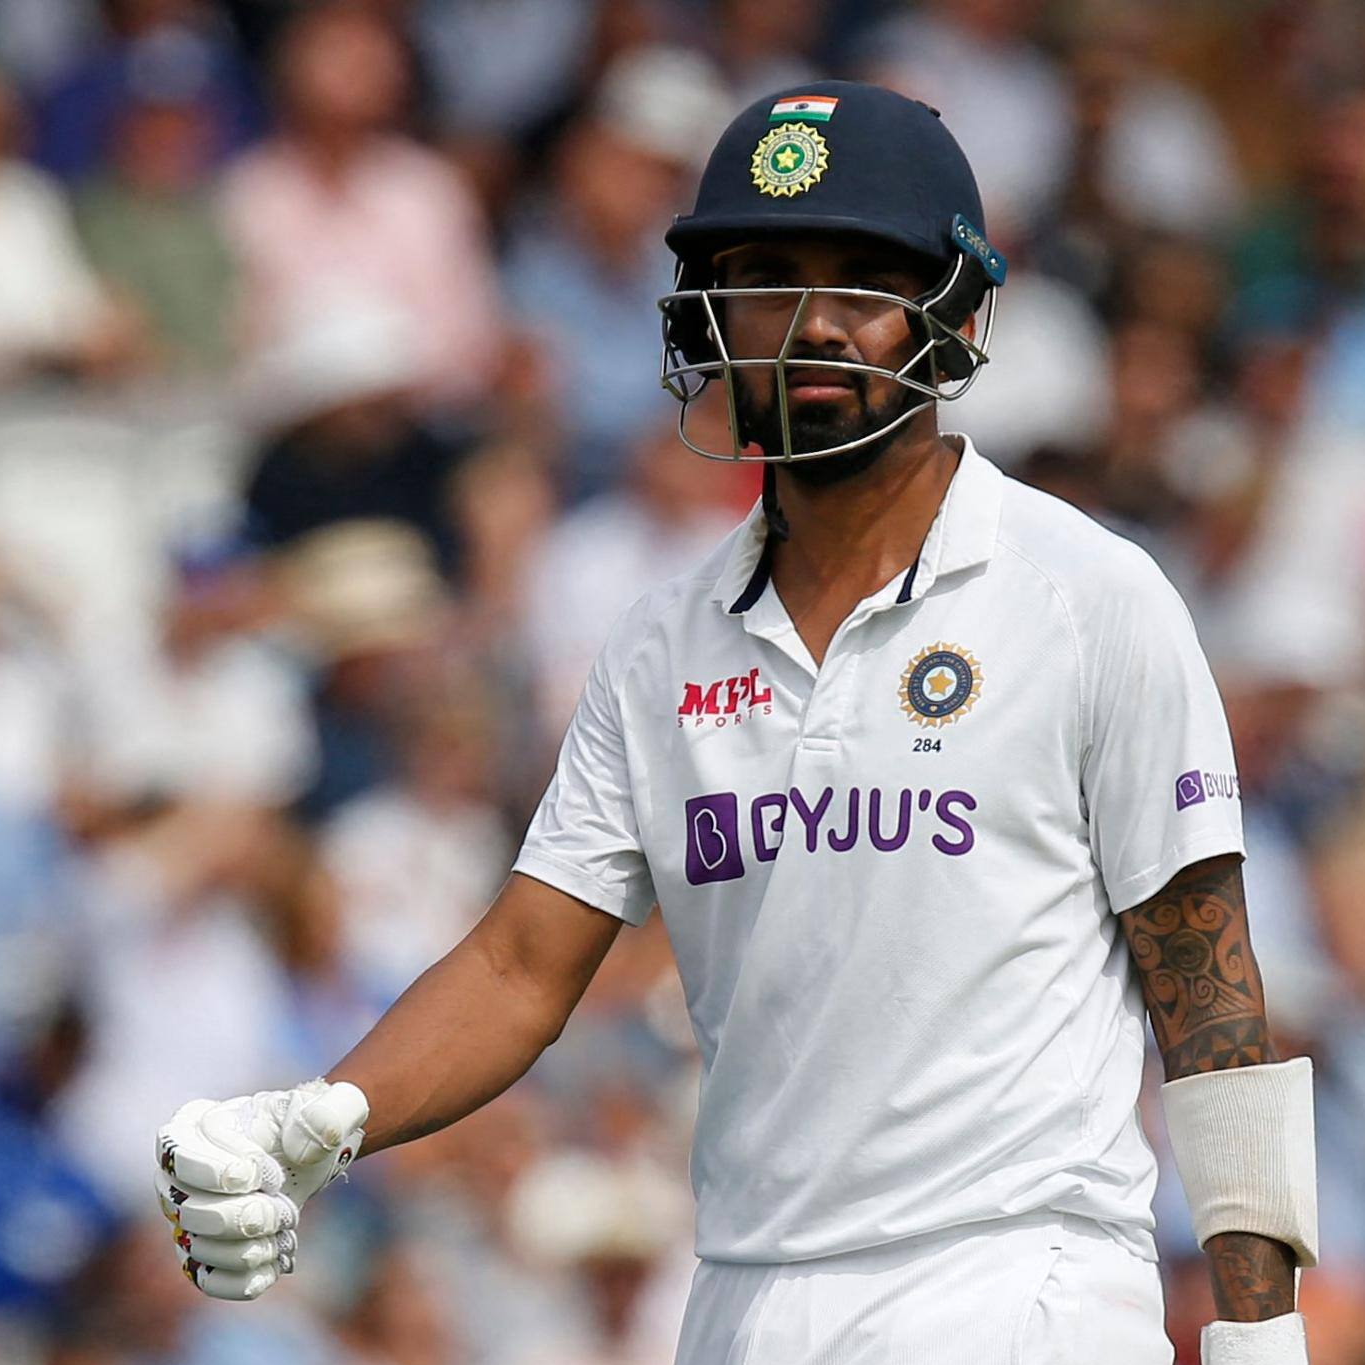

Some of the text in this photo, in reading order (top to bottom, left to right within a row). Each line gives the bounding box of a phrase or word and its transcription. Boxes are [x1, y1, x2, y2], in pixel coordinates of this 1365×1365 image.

[678, 667, 771, 716] MPL
[678, 705, 771, 728] SPORTS
[912, 738, 941, 753] 284
[1204, 772, 1238, 799] BYJU'
[751, 787, 977, 863] BYJU'S
